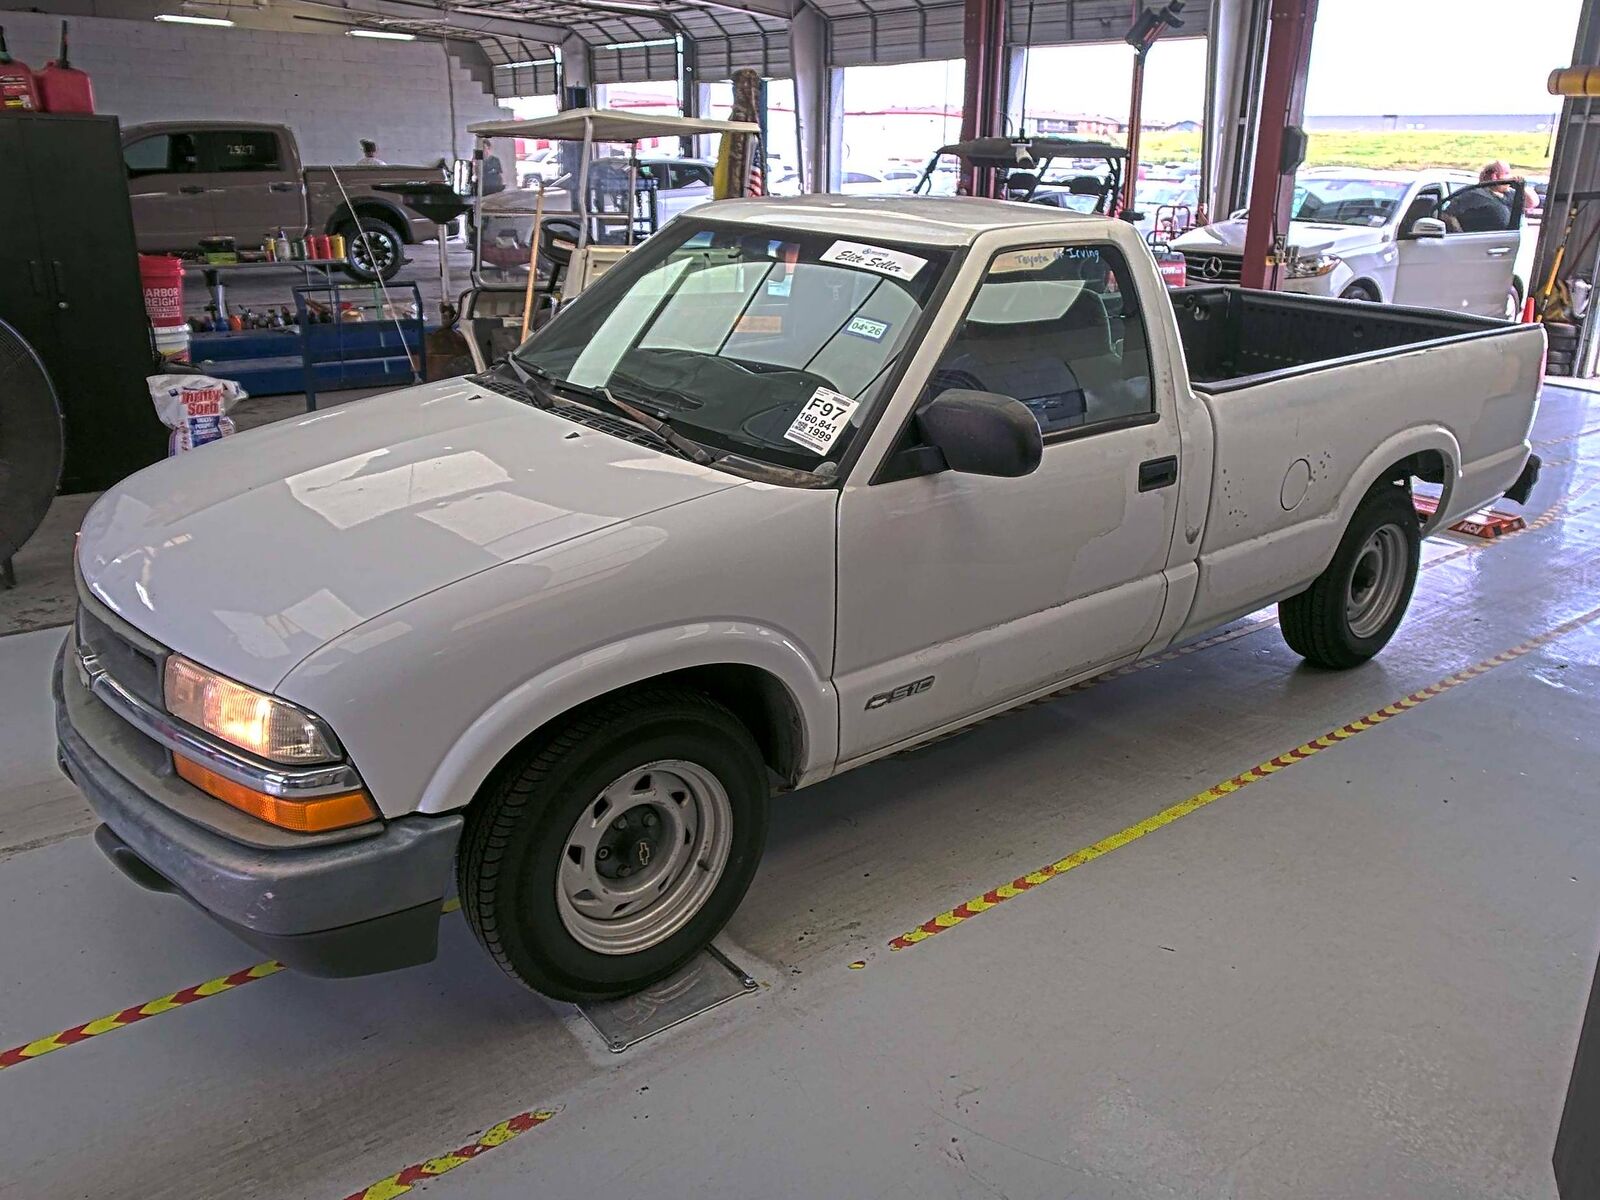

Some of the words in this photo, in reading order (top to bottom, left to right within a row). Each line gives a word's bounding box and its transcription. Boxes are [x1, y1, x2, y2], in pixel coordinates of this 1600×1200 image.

[834, 250, 864, 264] Elite
[865, 257, 904, 273] Seller
[1015, 255, 1049, 267] Toyota
[1066, 246, 1100, 263] Irving
[144, 296, 179, 307] REIGHT
[807, 397, 846, 421] F97
[799, 412, 838, 433] 160,841
[807, 426, 832, 442] 1999
